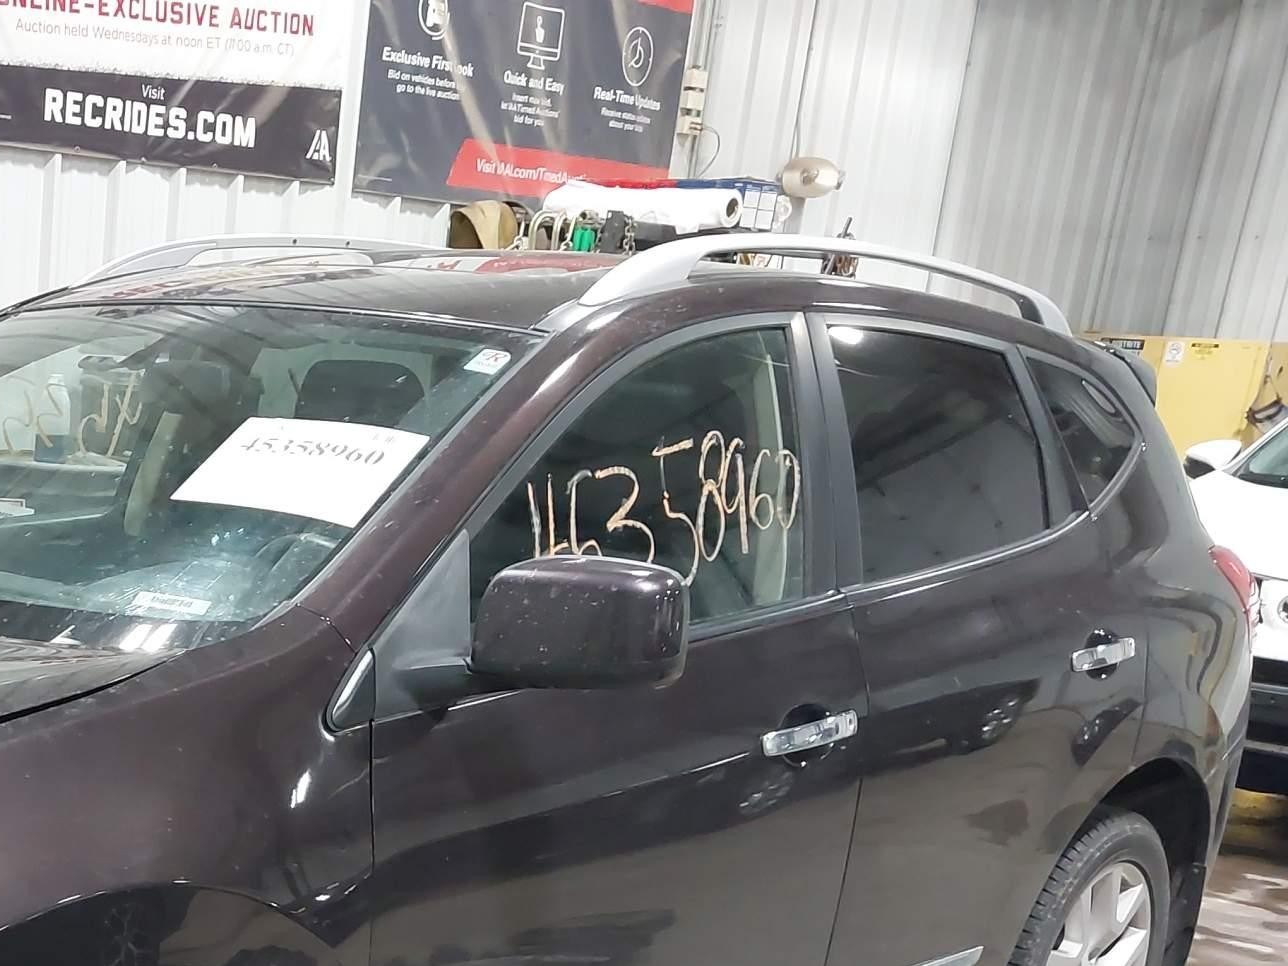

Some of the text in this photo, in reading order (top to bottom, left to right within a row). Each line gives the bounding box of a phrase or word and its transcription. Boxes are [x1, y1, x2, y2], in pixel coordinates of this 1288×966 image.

[15, 18, 61, 36] Auction
[64, 23, 89, 38] held
[92, 26, 159, 47] Wednesdays
[161, 34, 172, 46] at
[176, 36, 202, 49] noon
[206, 37, 221, 49] ET
[229, 7, 314, 36] AUCTION
[382, 46, 474, 77] Exclusive Firs ook
[387, 69, 400, 80] Bid
[401, 73, 410, 81] on
[503, 70, 564, 95] Quick and Easy
[141, 84, 166, 100] Visit
[396, 84, 406, 93] go
[406, 84, 414, 93] to
[594, 86, 661, 111] Real-Time Updates
[43, 87, 257, 148] RECRIDES.COM
[476, 158, 497, 174] Visit
[241, 437, 385, 464] 45358960
